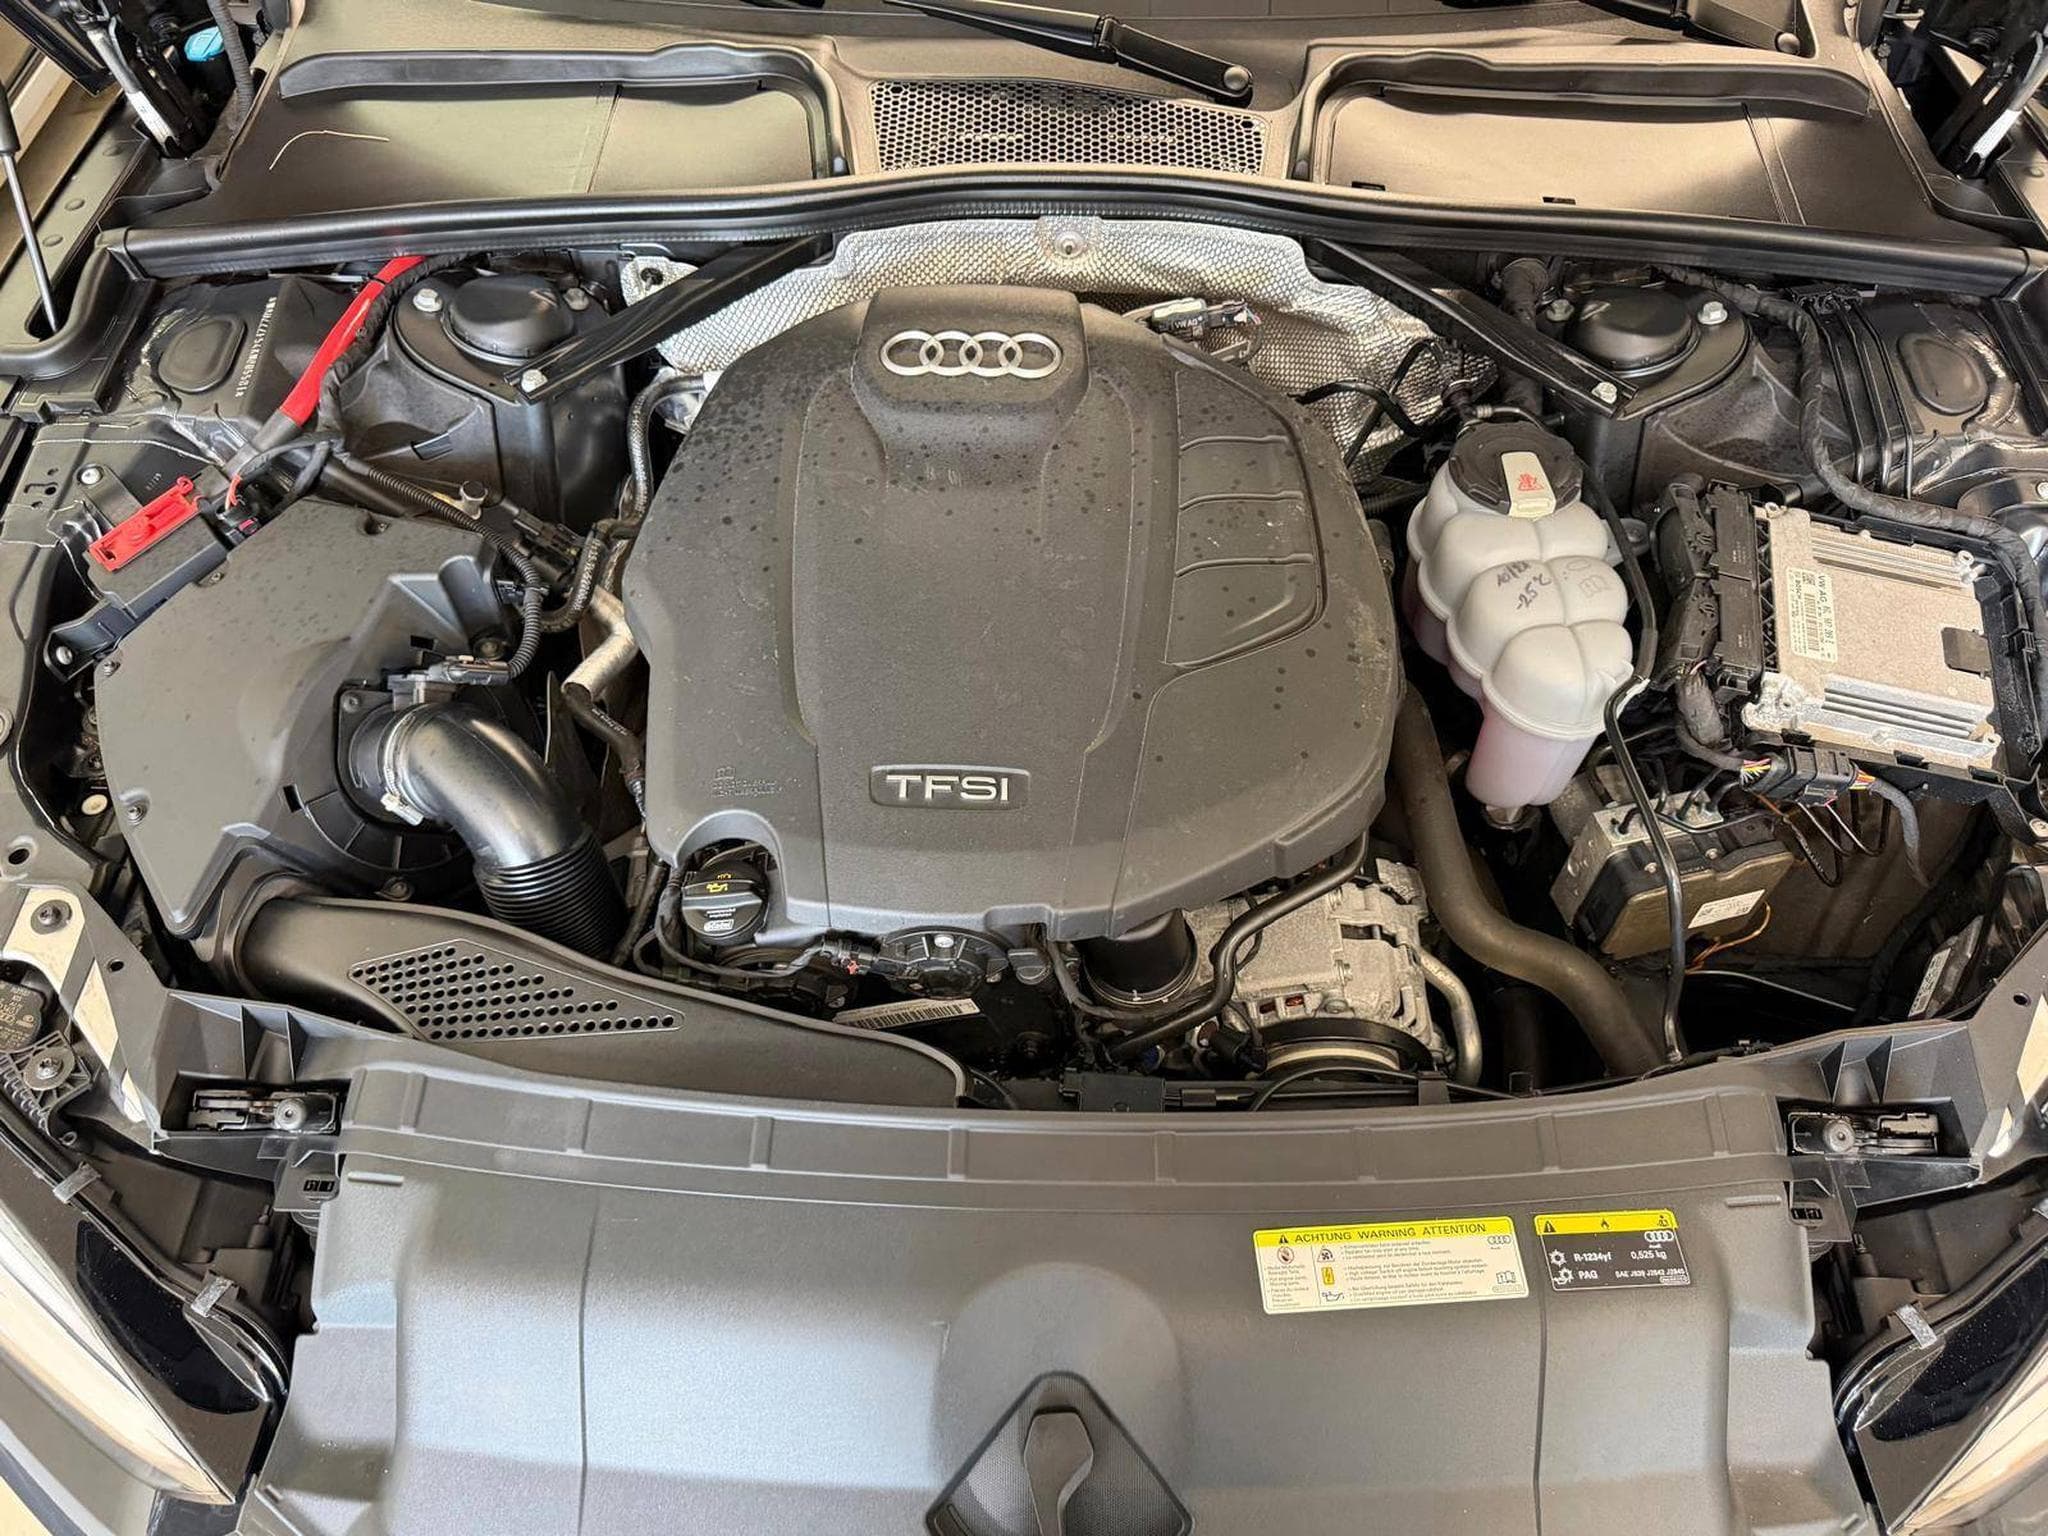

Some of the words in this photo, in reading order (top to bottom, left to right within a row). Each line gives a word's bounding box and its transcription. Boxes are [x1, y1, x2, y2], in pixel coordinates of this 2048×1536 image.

[886, 775, 1009, 801] TFSI
[1295, 1231, 1352, 1243] ACHTUNG
[1357, 1228, 1416, 1239] WARNING
[1422, 1223, 1487, 1236] ATTENTION
[1573, 1251, 1612, 1263] R-1234yf
[1630, 1251, 1655, 1260] 0,525
[1655, 1250, 1667, 1261] kg
[1578, 1270, 1599, 1280] PAG
